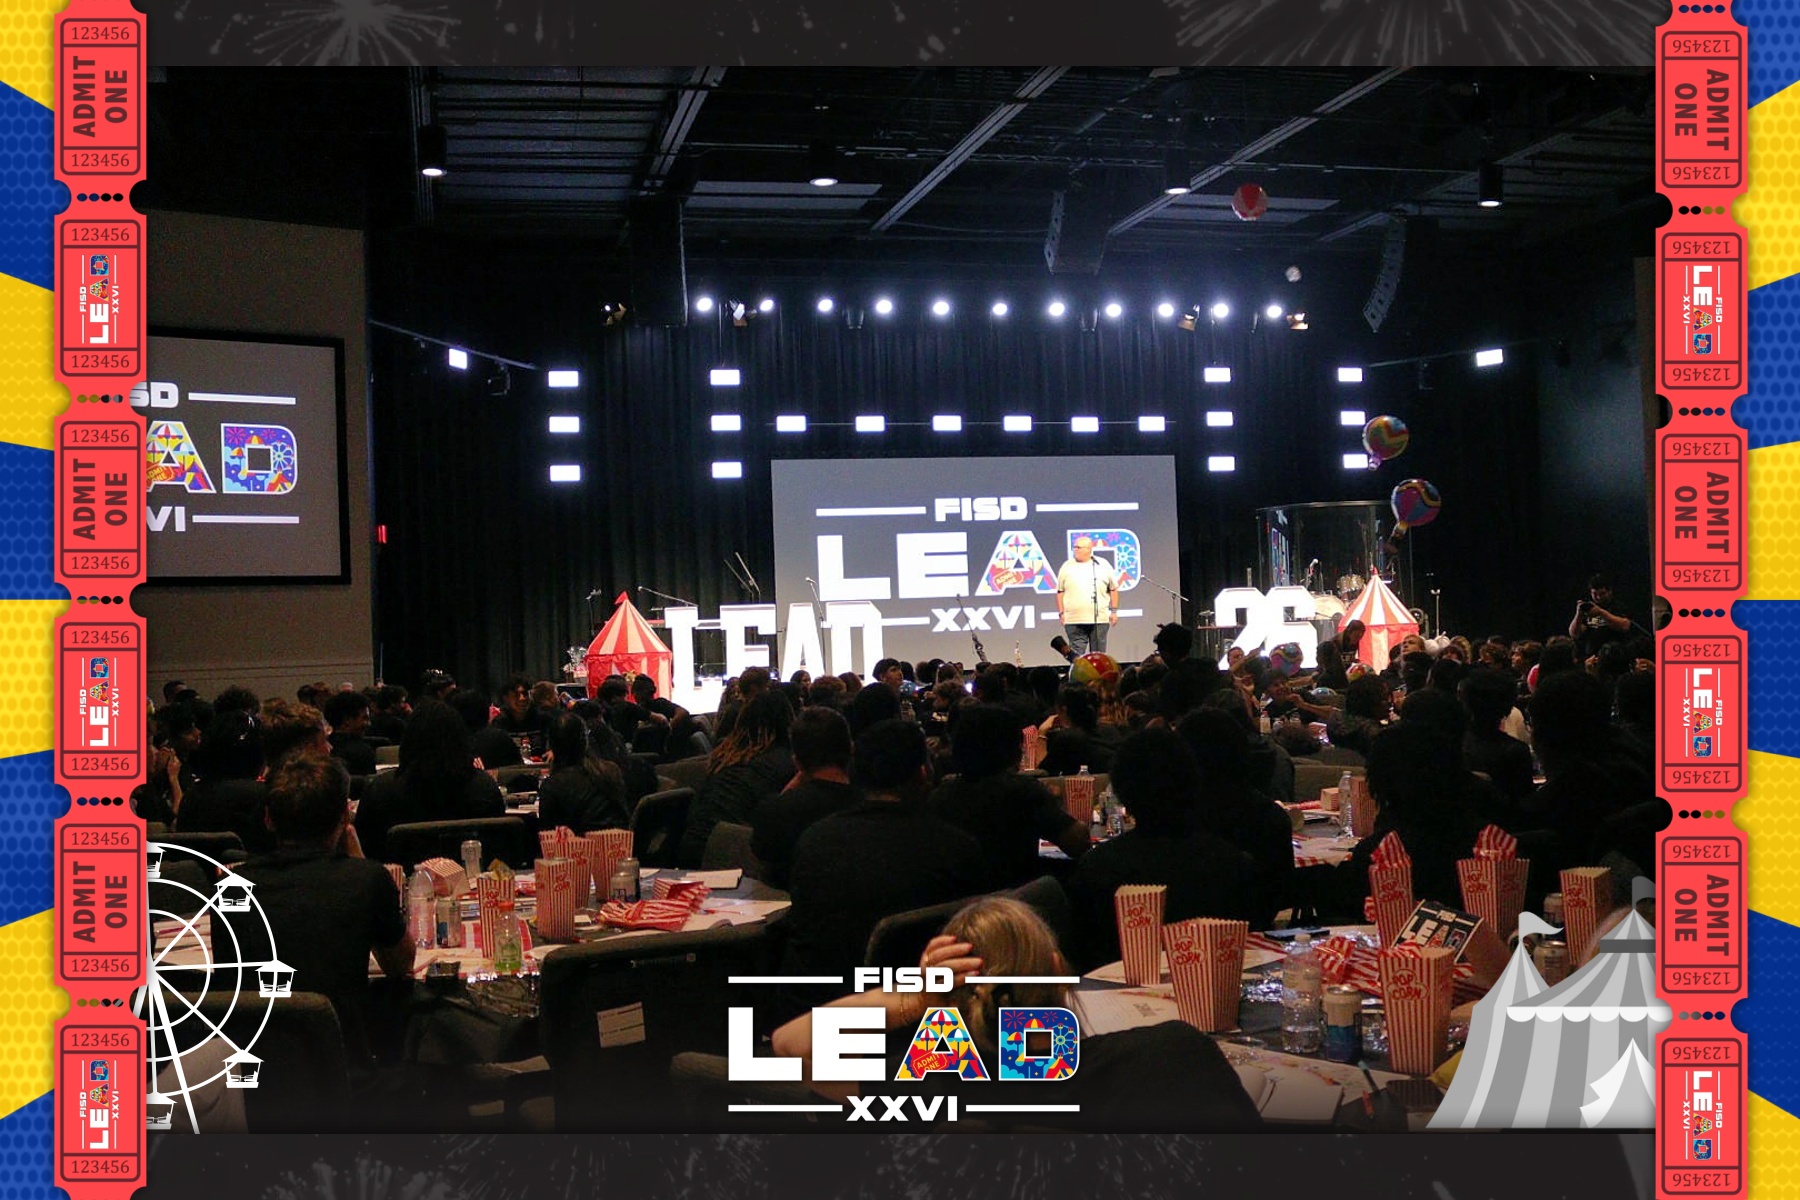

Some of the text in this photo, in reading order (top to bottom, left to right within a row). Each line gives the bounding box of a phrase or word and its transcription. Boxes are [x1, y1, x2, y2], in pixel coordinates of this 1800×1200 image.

[129, 382, 179, 408] SD
[146, 420, 298, 495] AD
[146, 506, 186, 532] VI
[934, 496, 1028, 522] FISD
[816, 528, 1142, 601] LEAD
[931, 605, 1035, 632] XXVI
[1214, 586, 1319, 670] 26
[664, 601, 884, 714] LEAD
[1127, 916, 1152, 929] CORN
[1128, 906, 1145, 918] POP
[1174, 940, 1193, 952] POP
[1175, 952, 1201, 965] CORN
[1392, 974, 1414, 985] POP
[1393, 988, 1422, 1000] CORN
